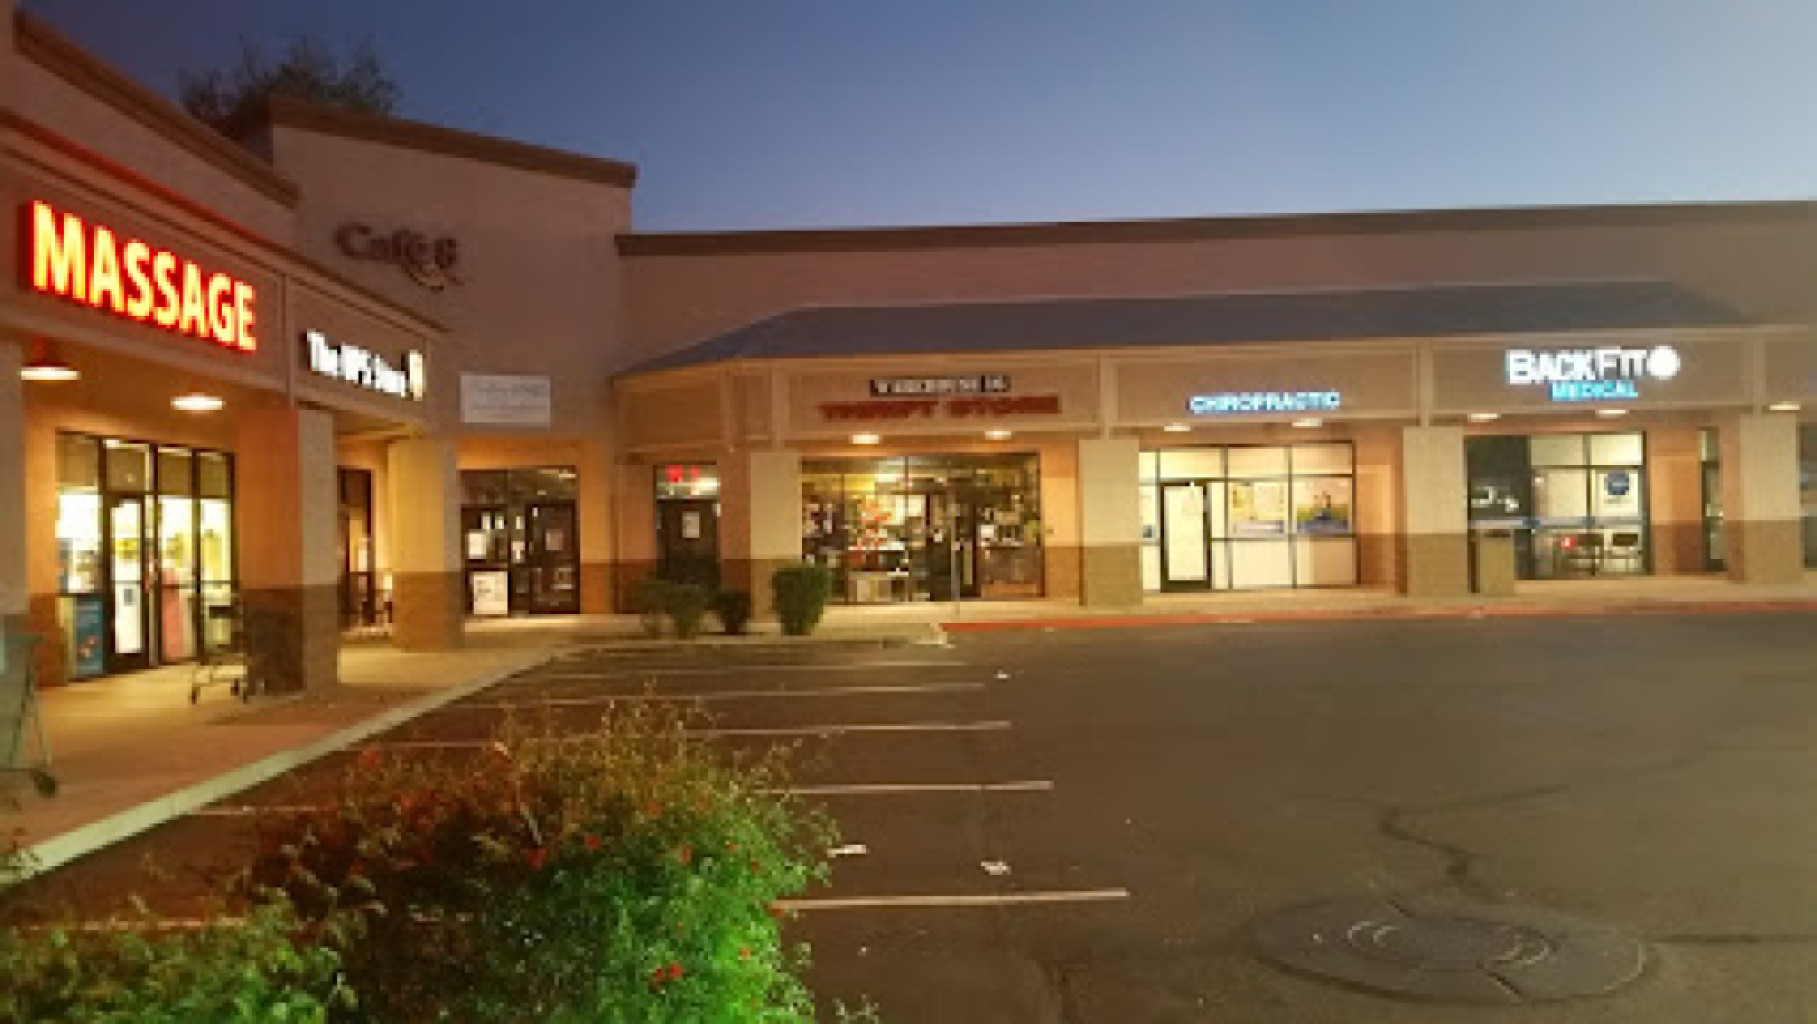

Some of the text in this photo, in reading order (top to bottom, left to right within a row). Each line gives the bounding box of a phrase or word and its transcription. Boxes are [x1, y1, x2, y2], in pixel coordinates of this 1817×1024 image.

[32, 199, 257, 352] MASSAGE
[305, 328, 340, 380] The
[872, 377, 981, 395] WAREHOUSE
[1551, 382, 1639, 401] MEDICAL
[818, 396, 1060, 421] THRIFT STORE
[1189, 391, 1341, 413] CHIROPRACTIC
